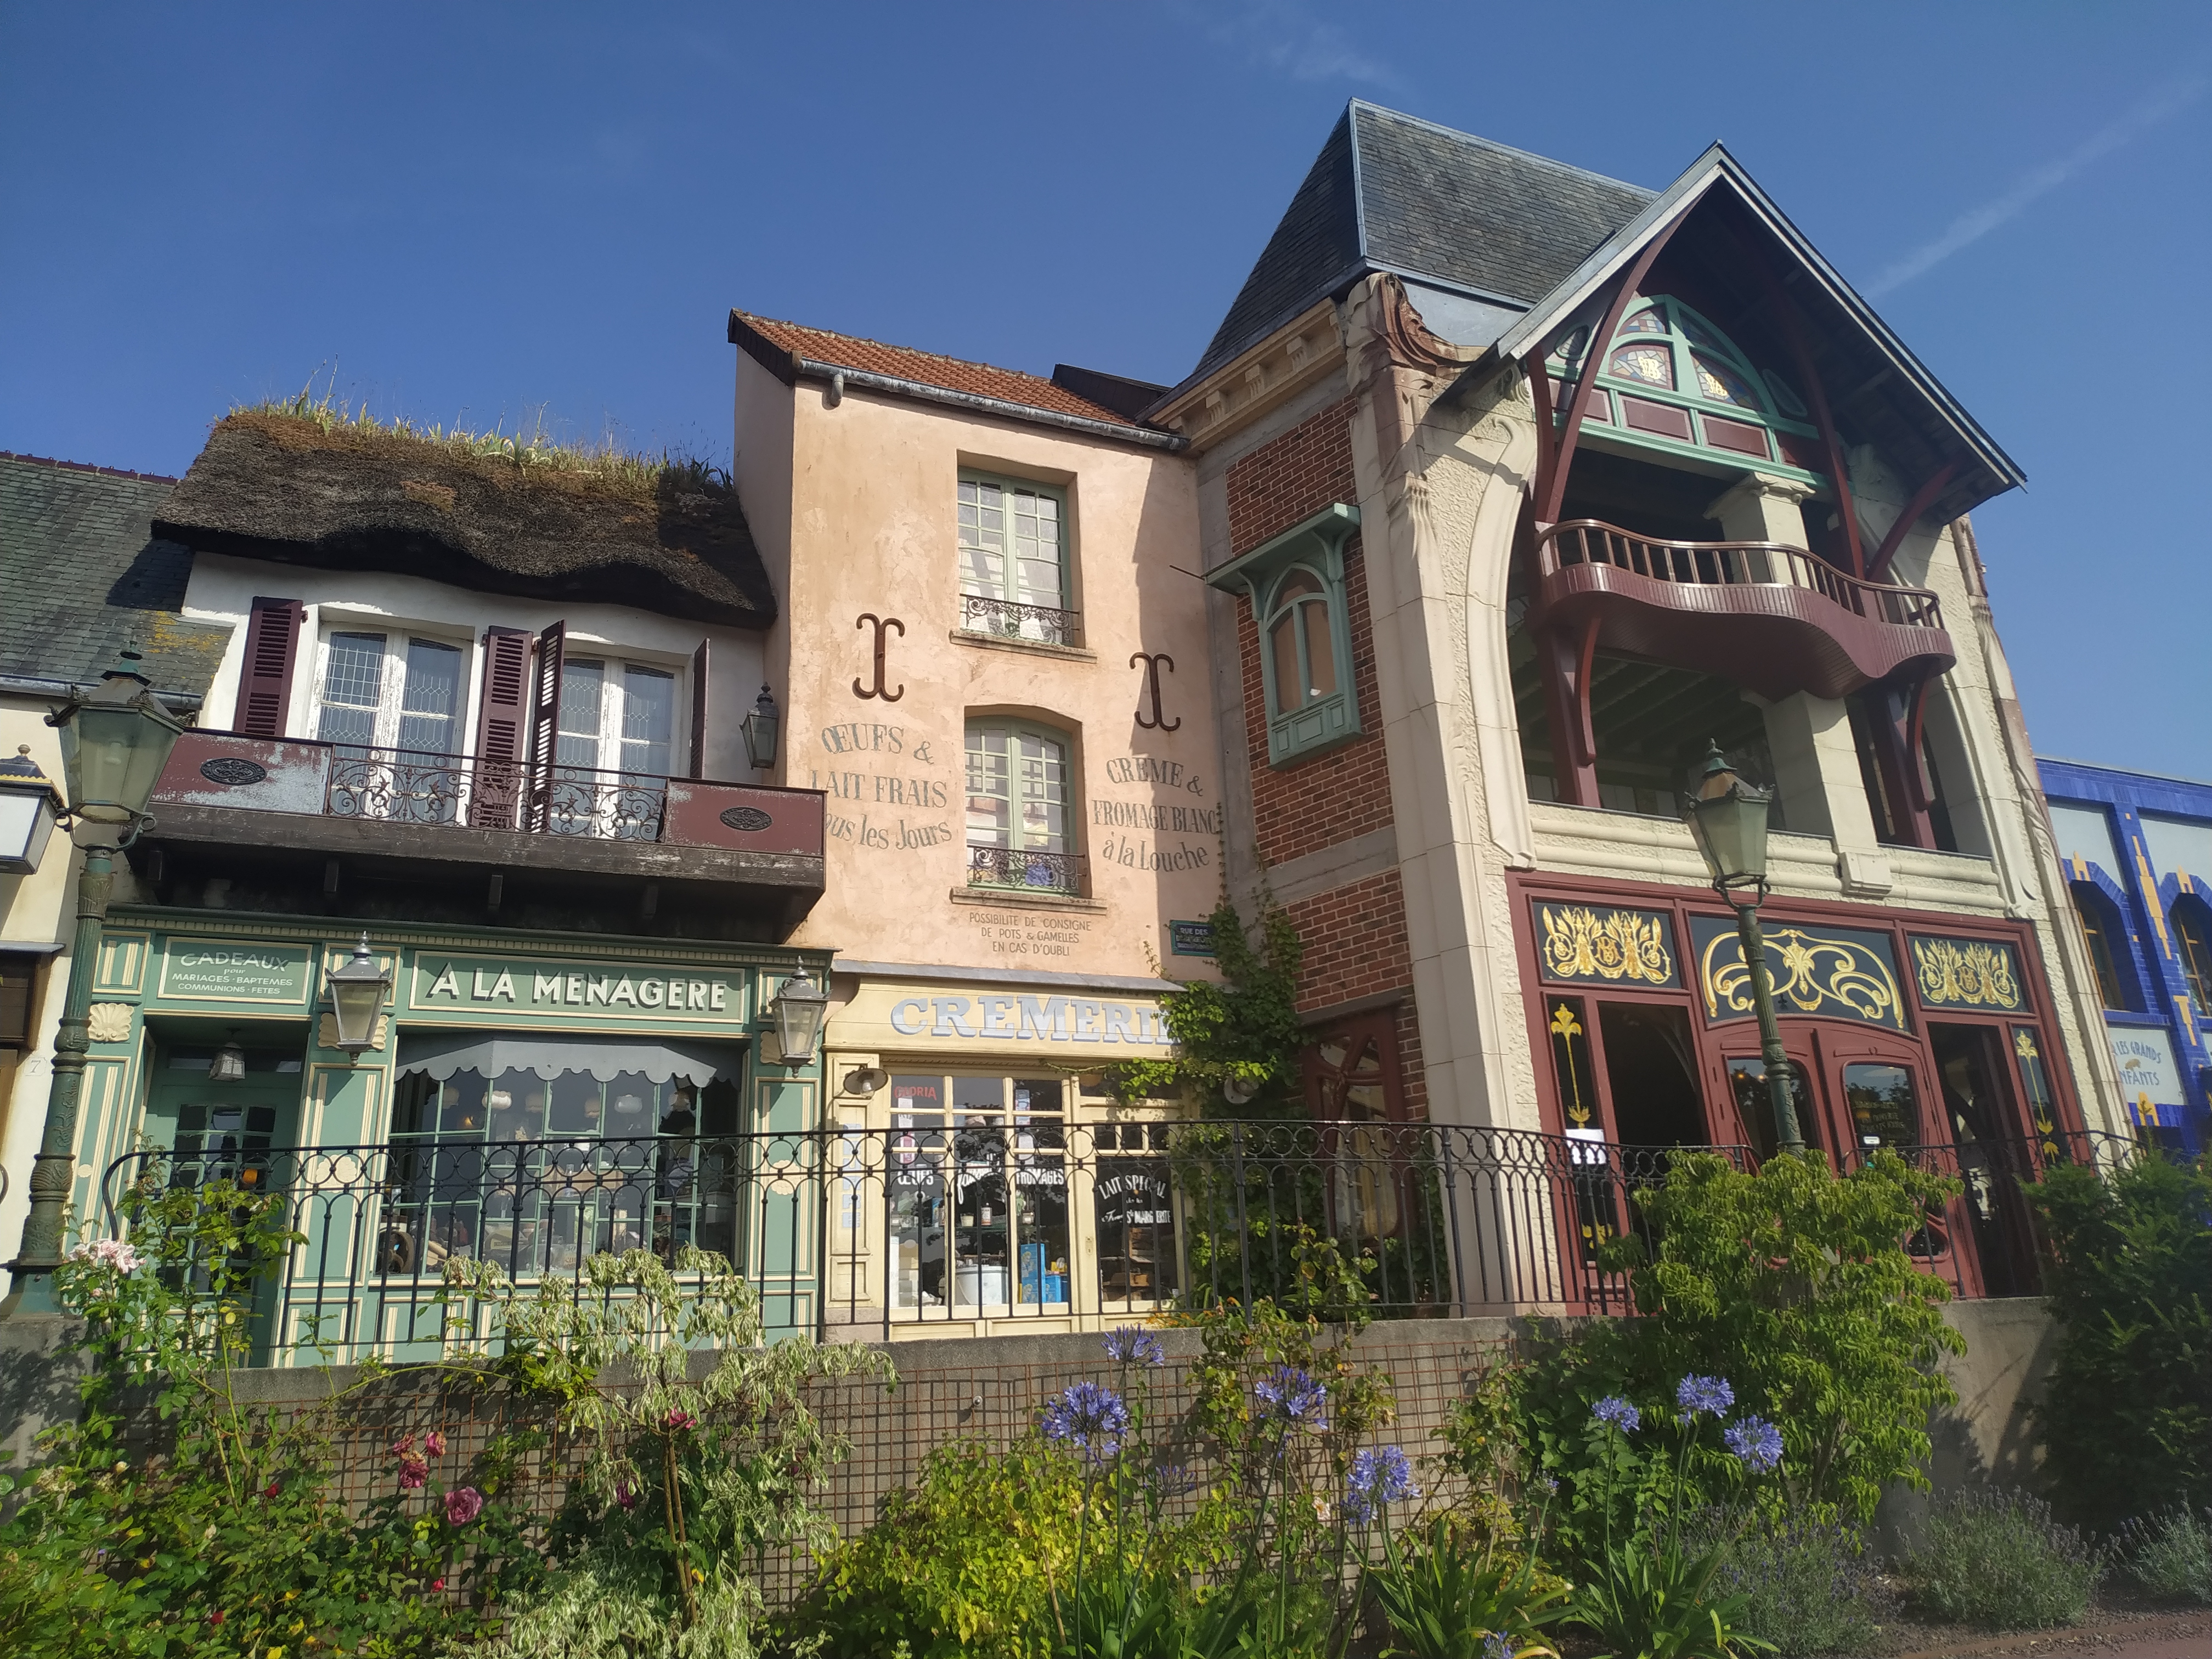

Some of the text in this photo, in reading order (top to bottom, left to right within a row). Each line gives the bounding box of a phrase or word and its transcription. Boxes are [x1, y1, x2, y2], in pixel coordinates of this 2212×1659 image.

[913, 741, 934, 765] &
[1106, 757, 1203, 797] CREME &
[873, 775, 947, 808] FRAIS
[1092, 799, 1218, 835] FROMAGE BLANC
[826, 813, 952, 850] ous les Jours
[1116, 835, 1135, 868] la
[1139, 841, 1210, 872] Louche
[969, 912, 1092, 931] POSSIBILITE DE CONSIGNE
[981, 927, 992, 938] DE
[1000, 928, 1021, 939] POTS
[1037, 931, 1079, 943] GAMELLES
[993, 941, 1069, 956] EN CAS D'OUBLI
[180, 951, 289, 972] CADEAUX
[172, 973, 293, 986] MARIAGES BAPTEMES
[178, 983, 245, 992] COMMUNIONS
[426, 962, 727, 1012] A LA MENAGERE
[2116, 1041, 2129, 1054] LES
[2130, 1041, 2161, 1064] GRANDS
[30, 1060, 41, 1073] 7
[2119, 1071, 2159, 1086] NFANTS
[1016, 1168, 1064, 1185] FROMAGES
[1098, 1176, 1122, 1200] LAIT
